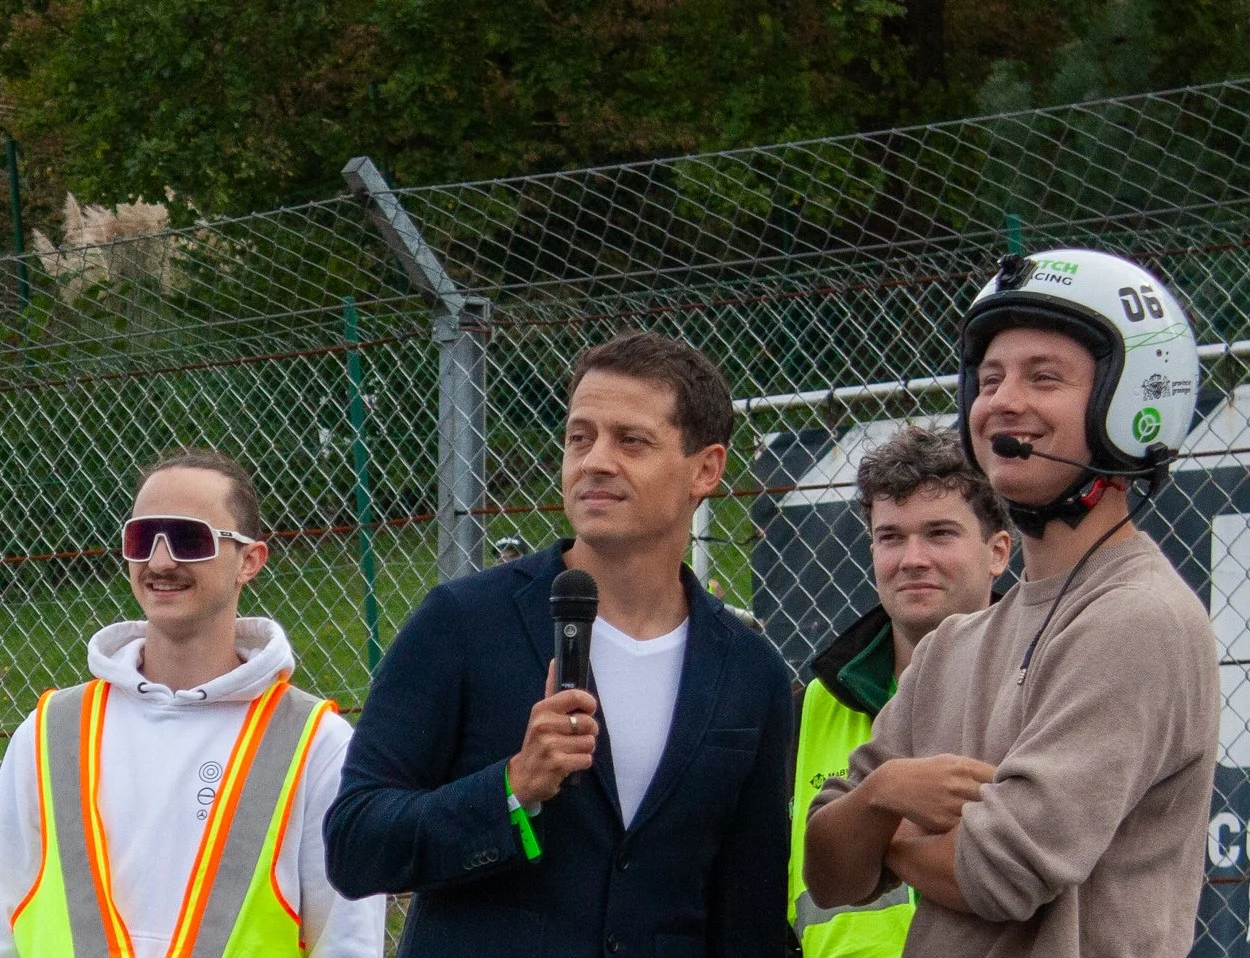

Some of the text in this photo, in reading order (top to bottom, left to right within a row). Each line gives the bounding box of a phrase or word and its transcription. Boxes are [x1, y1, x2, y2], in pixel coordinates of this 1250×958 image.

[1037, 259, 1079, 275] TCH
[1030, 272, 1073, 287] CING
[1117, 285, 1165, 323] 06
